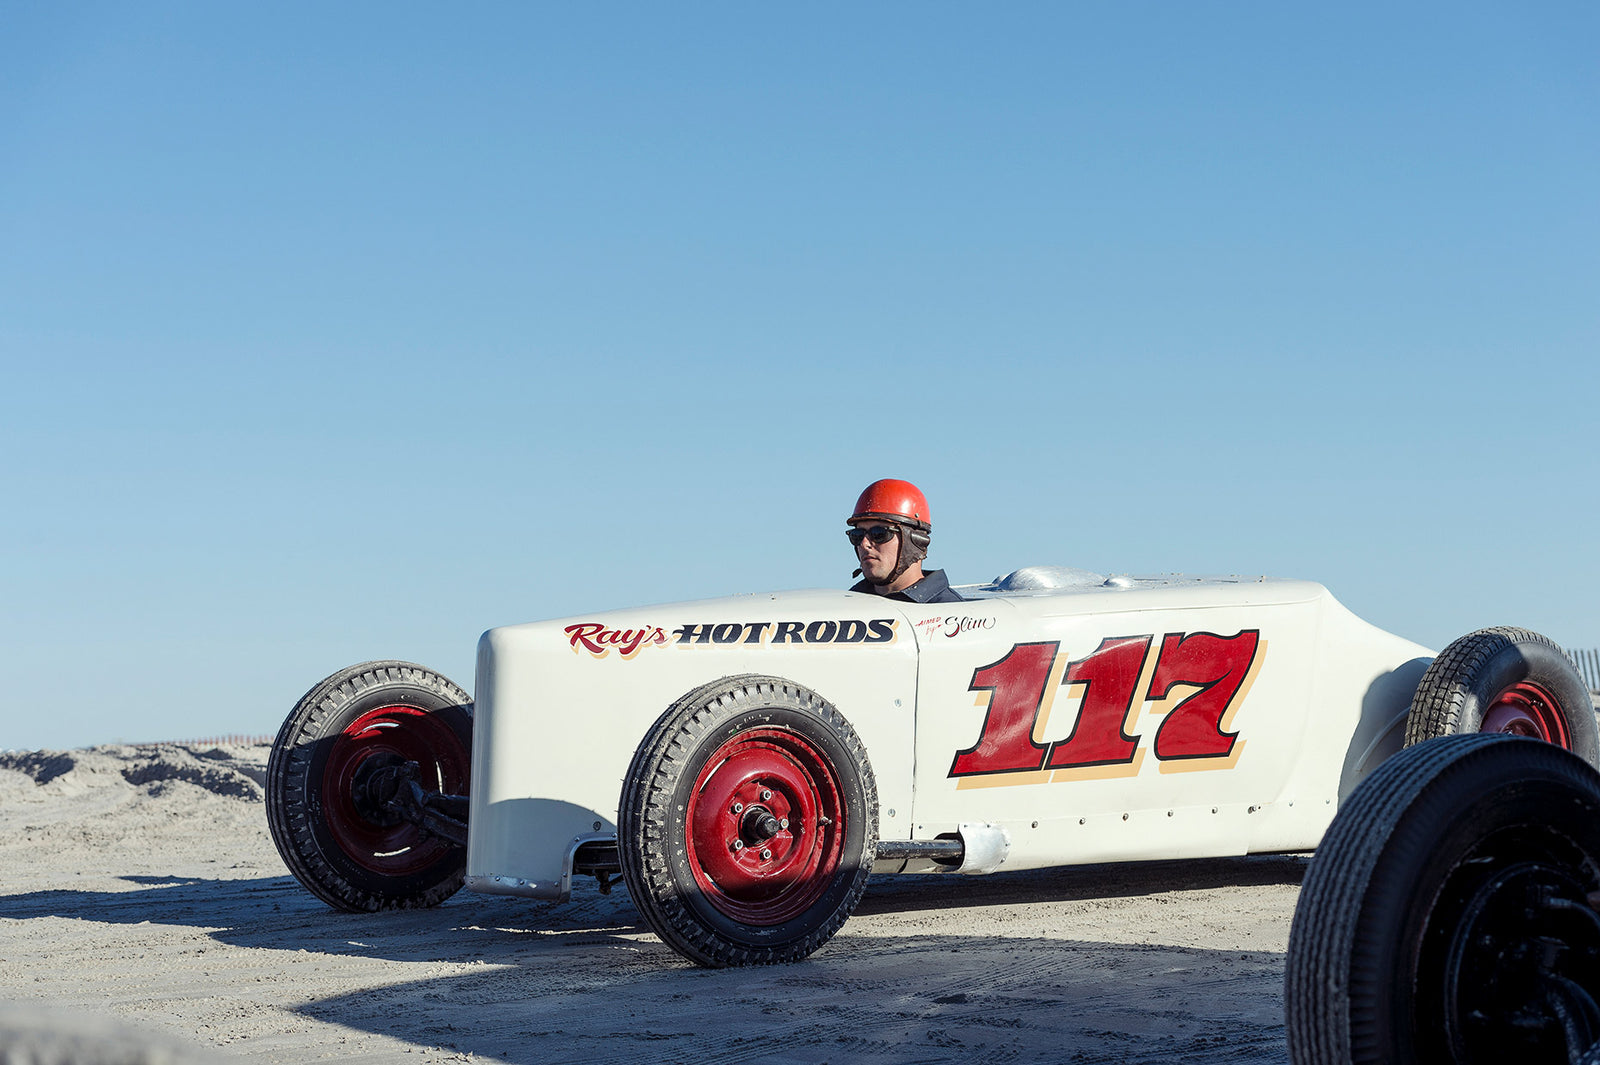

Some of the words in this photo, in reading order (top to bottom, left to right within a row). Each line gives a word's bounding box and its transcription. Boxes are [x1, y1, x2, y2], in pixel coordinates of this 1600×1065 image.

[564, 623, 669, 657] Ray's
[672, 622, 772, 645] HOT
[771, 619, 897, 645] RODS
[944, 616, 996, 638] Slim
[946, 628, 1263, 784] 117
